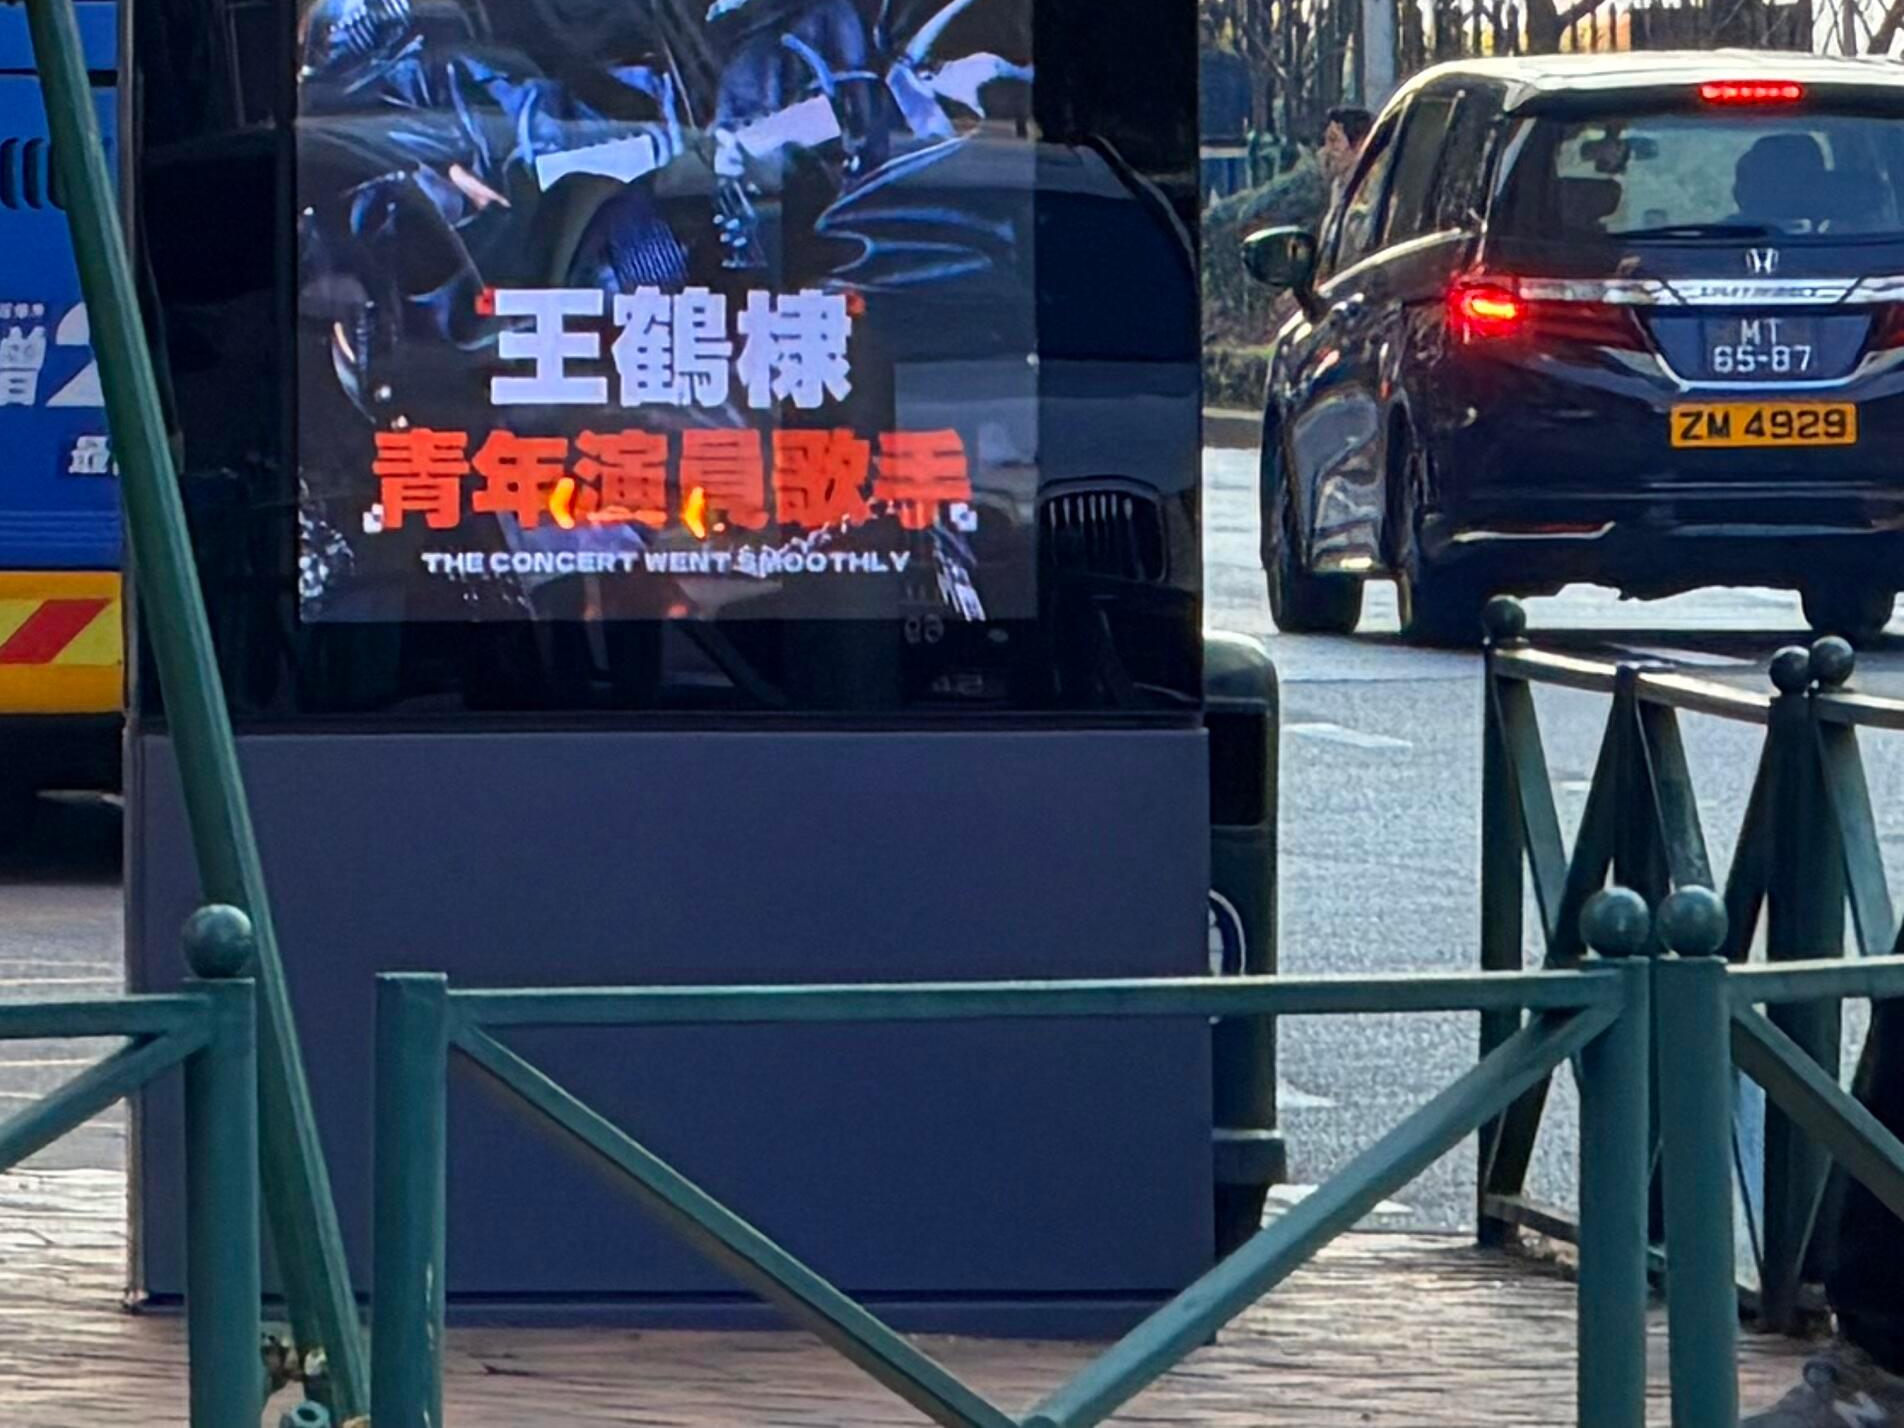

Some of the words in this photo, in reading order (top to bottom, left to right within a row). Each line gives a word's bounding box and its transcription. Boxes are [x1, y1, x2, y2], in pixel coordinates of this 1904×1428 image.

[1741, 317, 1781, 344] MT
[491, 285, 853, 409] 王鶴棣
[1713, 345, 1812, 373] 65-87
[1678, 410, 1731, 441] ZM
[1743, 408, 1847, 440] 4929
[372, 428, 972, 531] 青年演員歌手
[421, 551, 484, 574] THE
[490, 551, 639, 574] CONCERT
[645, 550, 731, 573] WENT
[737, 549, 912, 575] SMOOTHLY
